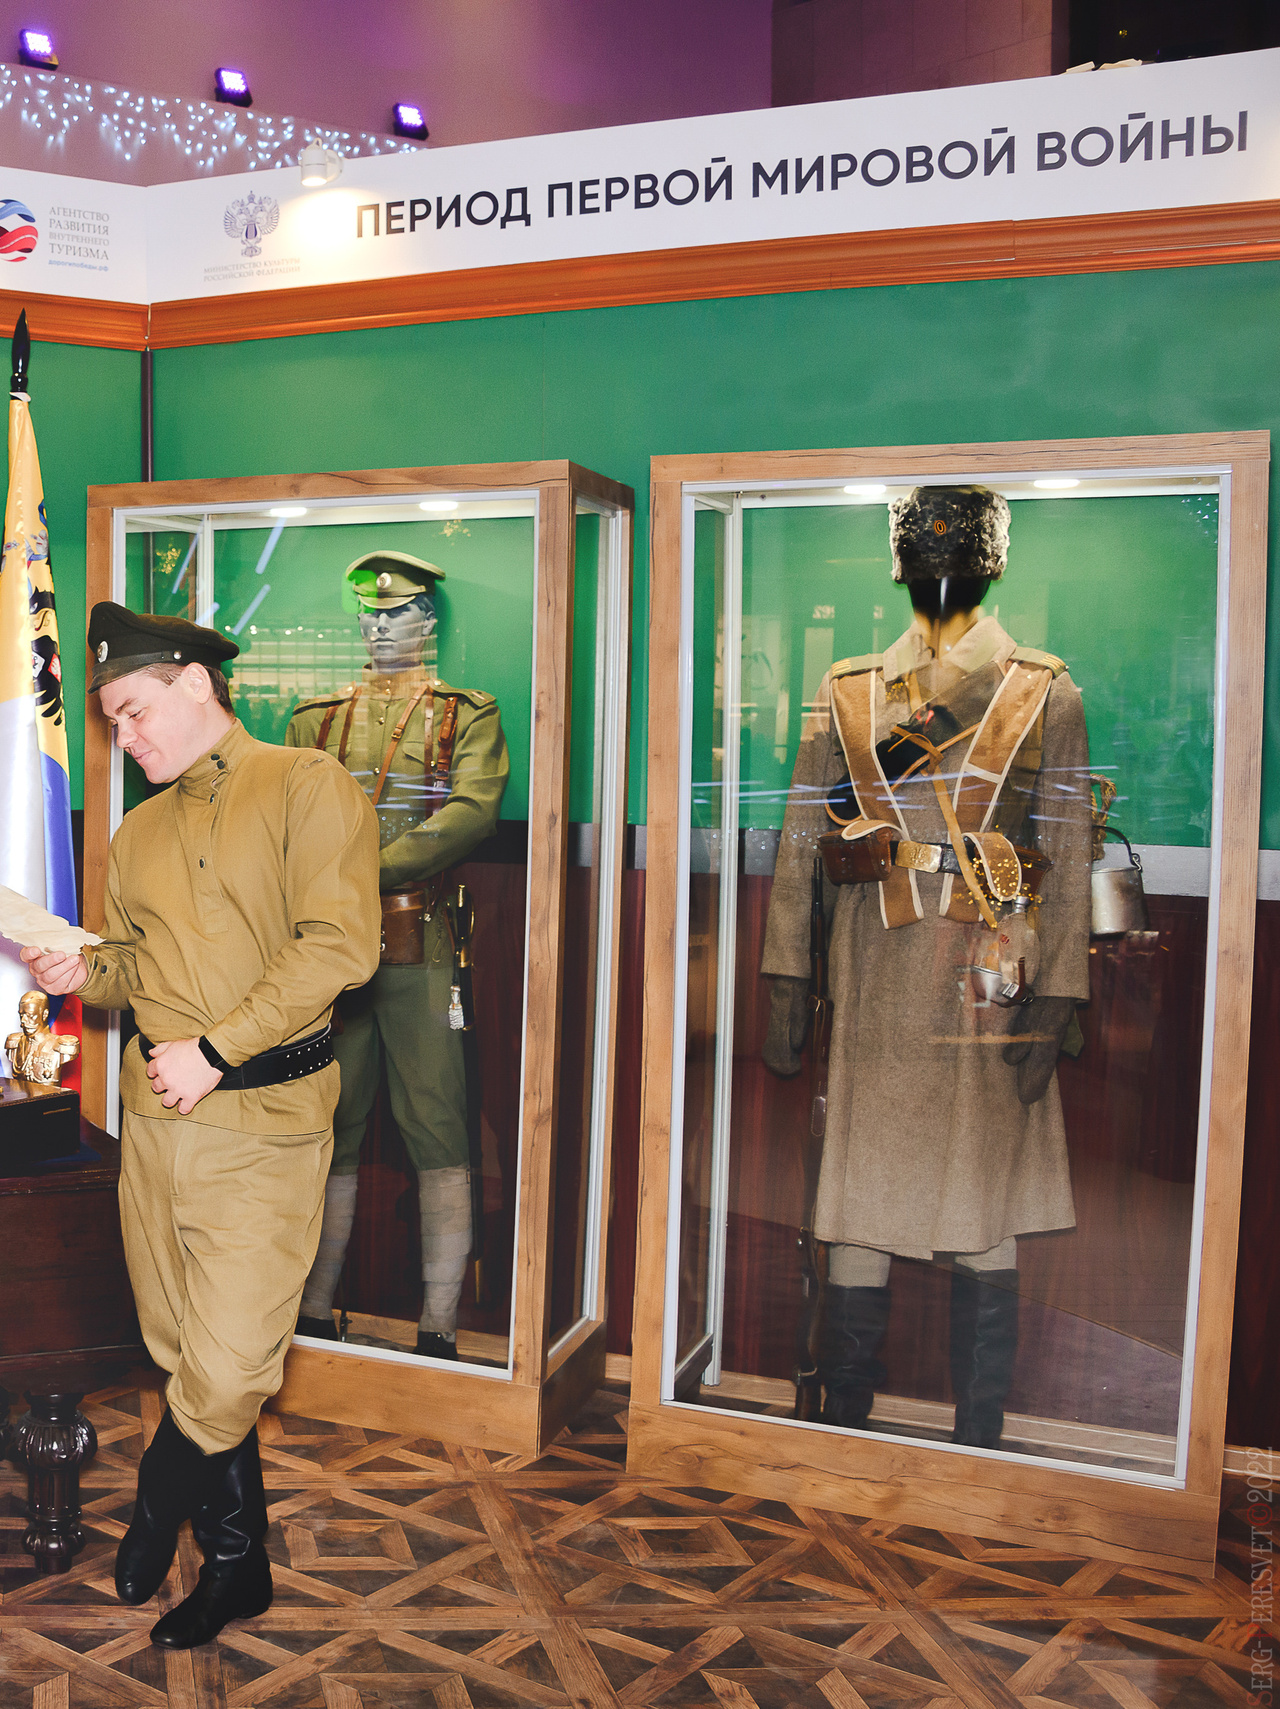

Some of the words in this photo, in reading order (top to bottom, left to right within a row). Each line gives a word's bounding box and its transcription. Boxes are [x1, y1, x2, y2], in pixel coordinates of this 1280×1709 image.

[356, 186, 532, 239] ПЕРИОД
[547, 156, 733, 218] ПЕРВОЙ
[752, 127, 1016, 198] МИРОВОЙ
[1037, 110, 1249, 172] ВОЙНЫ
[49, 206, 110, 223] АГЕНТСТВО
[49, 218, 109, 236] РАЗВИТИЯ
[49, 231, 110, 247] ВНУТРЕННЕГО
[49, 243, 109, 261] ТУРИЗМА
